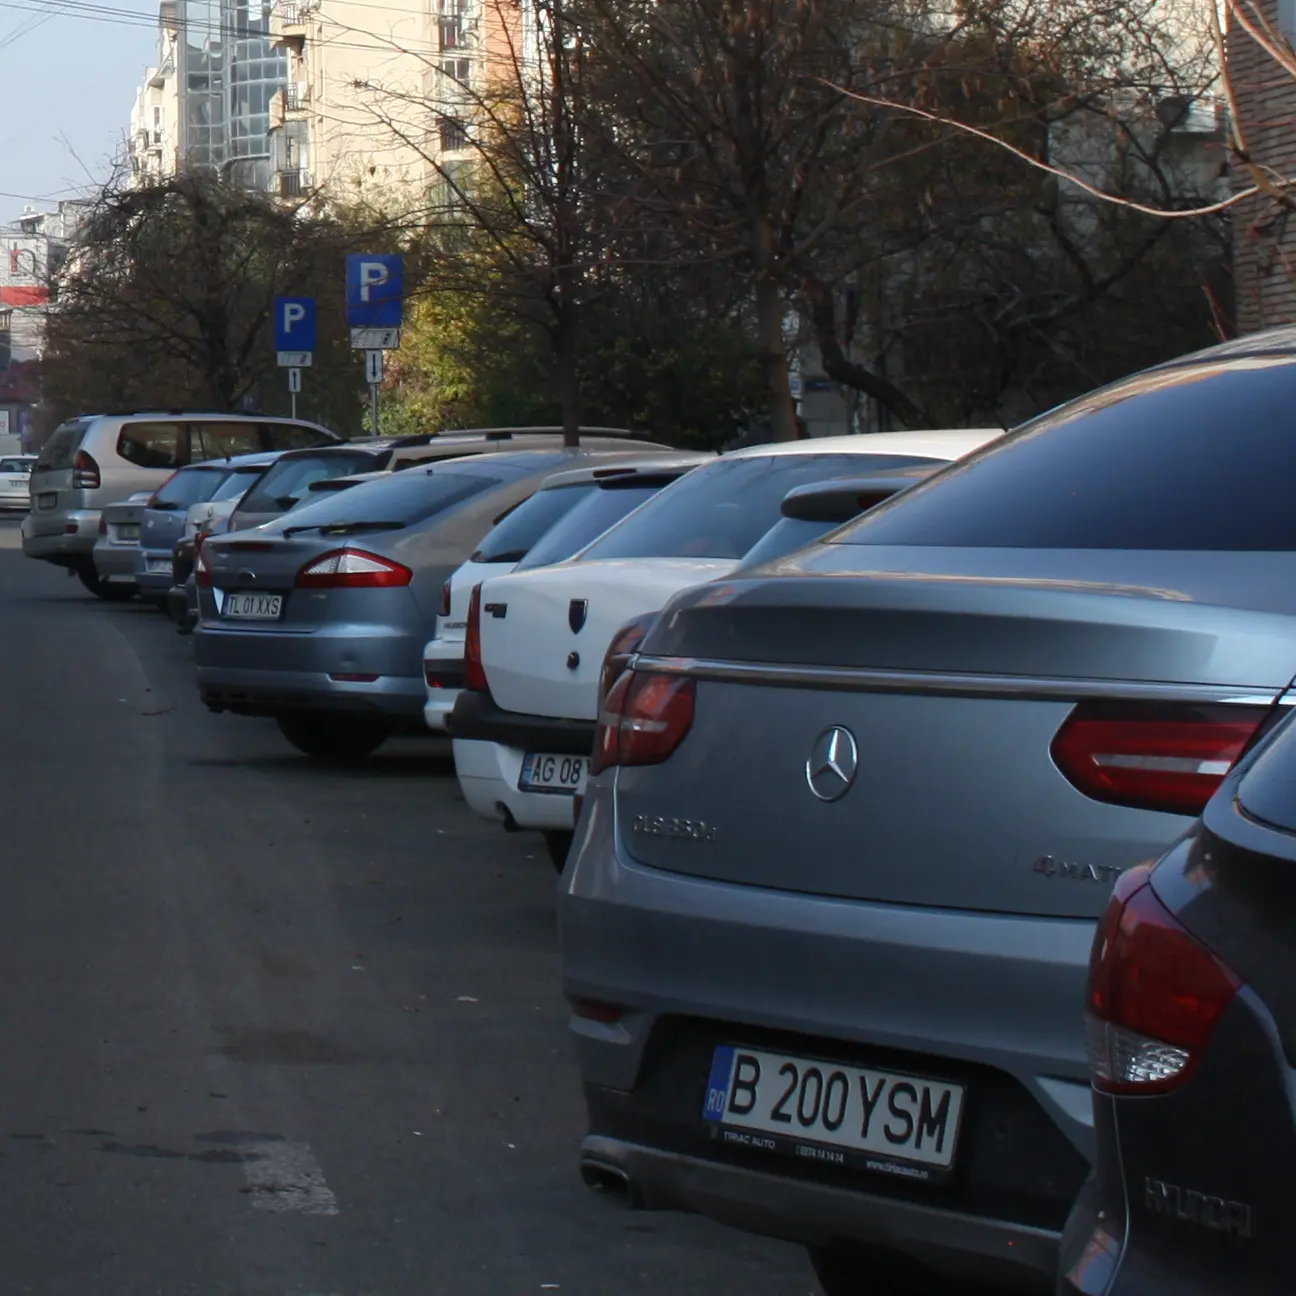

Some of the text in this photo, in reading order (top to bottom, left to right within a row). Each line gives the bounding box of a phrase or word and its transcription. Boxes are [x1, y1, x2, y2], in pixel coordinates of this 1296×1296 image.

[359, 261, 390, 302] P
[283, 302, 306, 334] P
[228, 596, 280, 615] TL 01 XXS
[530, 756, 583, 784] AG 08
[706, 1053, 952, 1154] RO B 200 YSM
